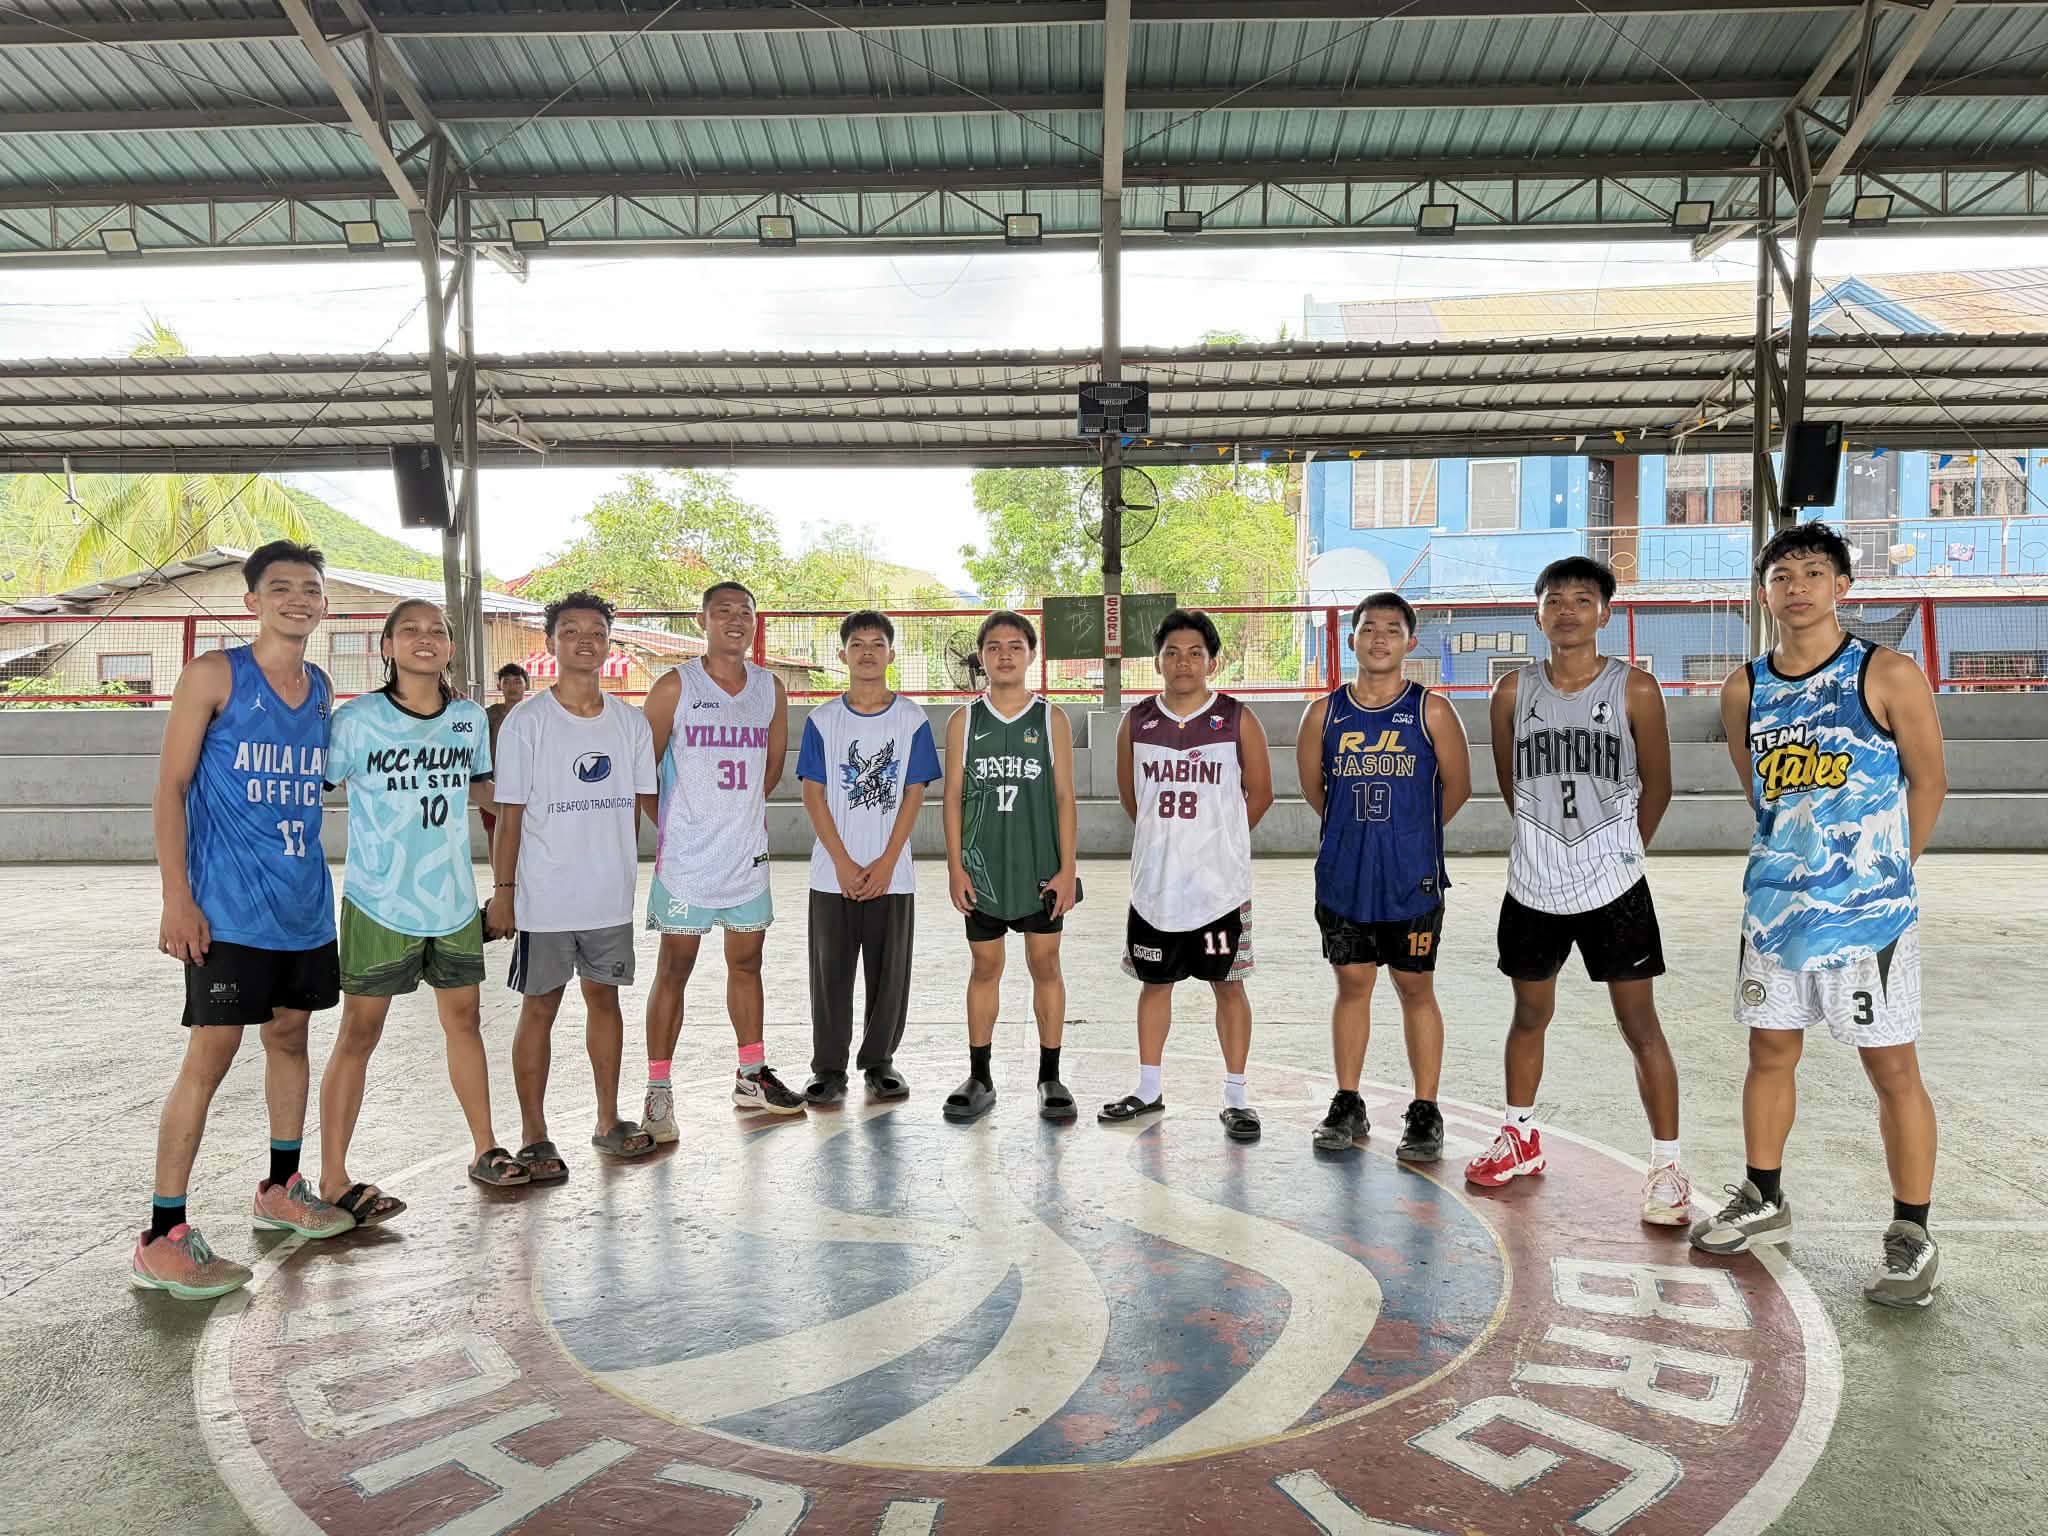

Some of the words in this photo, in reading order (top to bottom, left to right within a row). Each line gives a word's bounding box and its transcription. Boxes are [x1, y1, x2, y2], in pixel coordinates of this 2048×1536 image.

[1107, 597, 1118, 641] SCORE
[685, 725, 768, 749] VILLIAN
[1339, 730, 1407, 753] RJL
[1753, 726, 1806, 751] TEAM
[233, 741, 293, 774] AVILA
[366, 748, 410, 775] MCC
[413, 746, 474, 771] ALUMN
[1332, 754, 1416, 777] JASON
[387, 776, 419, 791] ALL
[428, 774, 466, 788] STA
[718, 760, 747, 790] 31
[420, 793, 449, 829] 10
[996, 785, 1019, 812] 17
[1158, 790, 1197, 819] 88
[1351, 782, 1392, 822] 19
[1561, 780, 1578, 819] 2
[276, 819, 306, 857] 17
[1204, 931, 1231, 955] 11
[1407, 932, 1432, 956] 19
[1852, 991, 1874, 1025] 3
